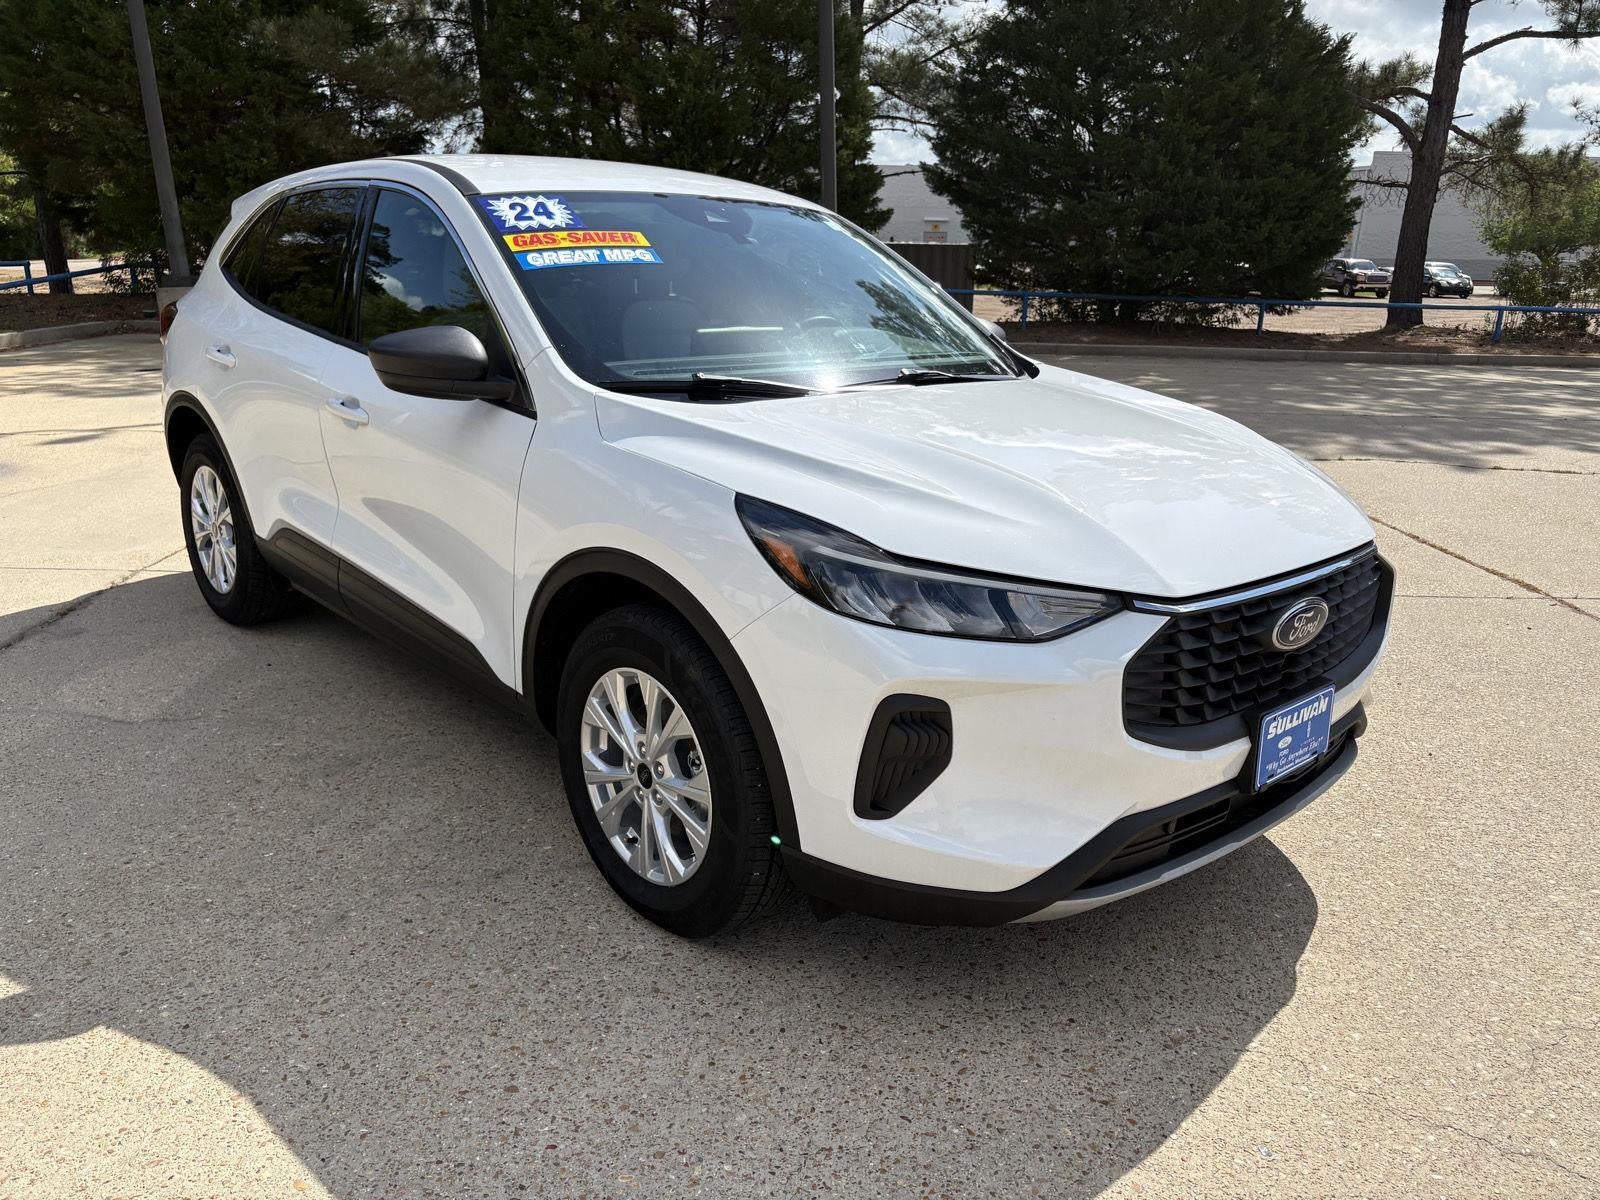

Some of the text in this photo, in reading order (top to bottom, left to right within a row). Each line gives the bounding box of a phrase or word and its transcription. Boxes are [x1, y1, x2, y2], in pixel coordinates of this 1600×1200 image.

[508, 202, 556, 222] 24
[512, 231, 640, 248] GAS-SAVER
[526, 249, 656, 266] GREAT MPG
[1289, 610, 1321, 641] Ford
[1267, 696, 1329, 740] SULLIVAN
